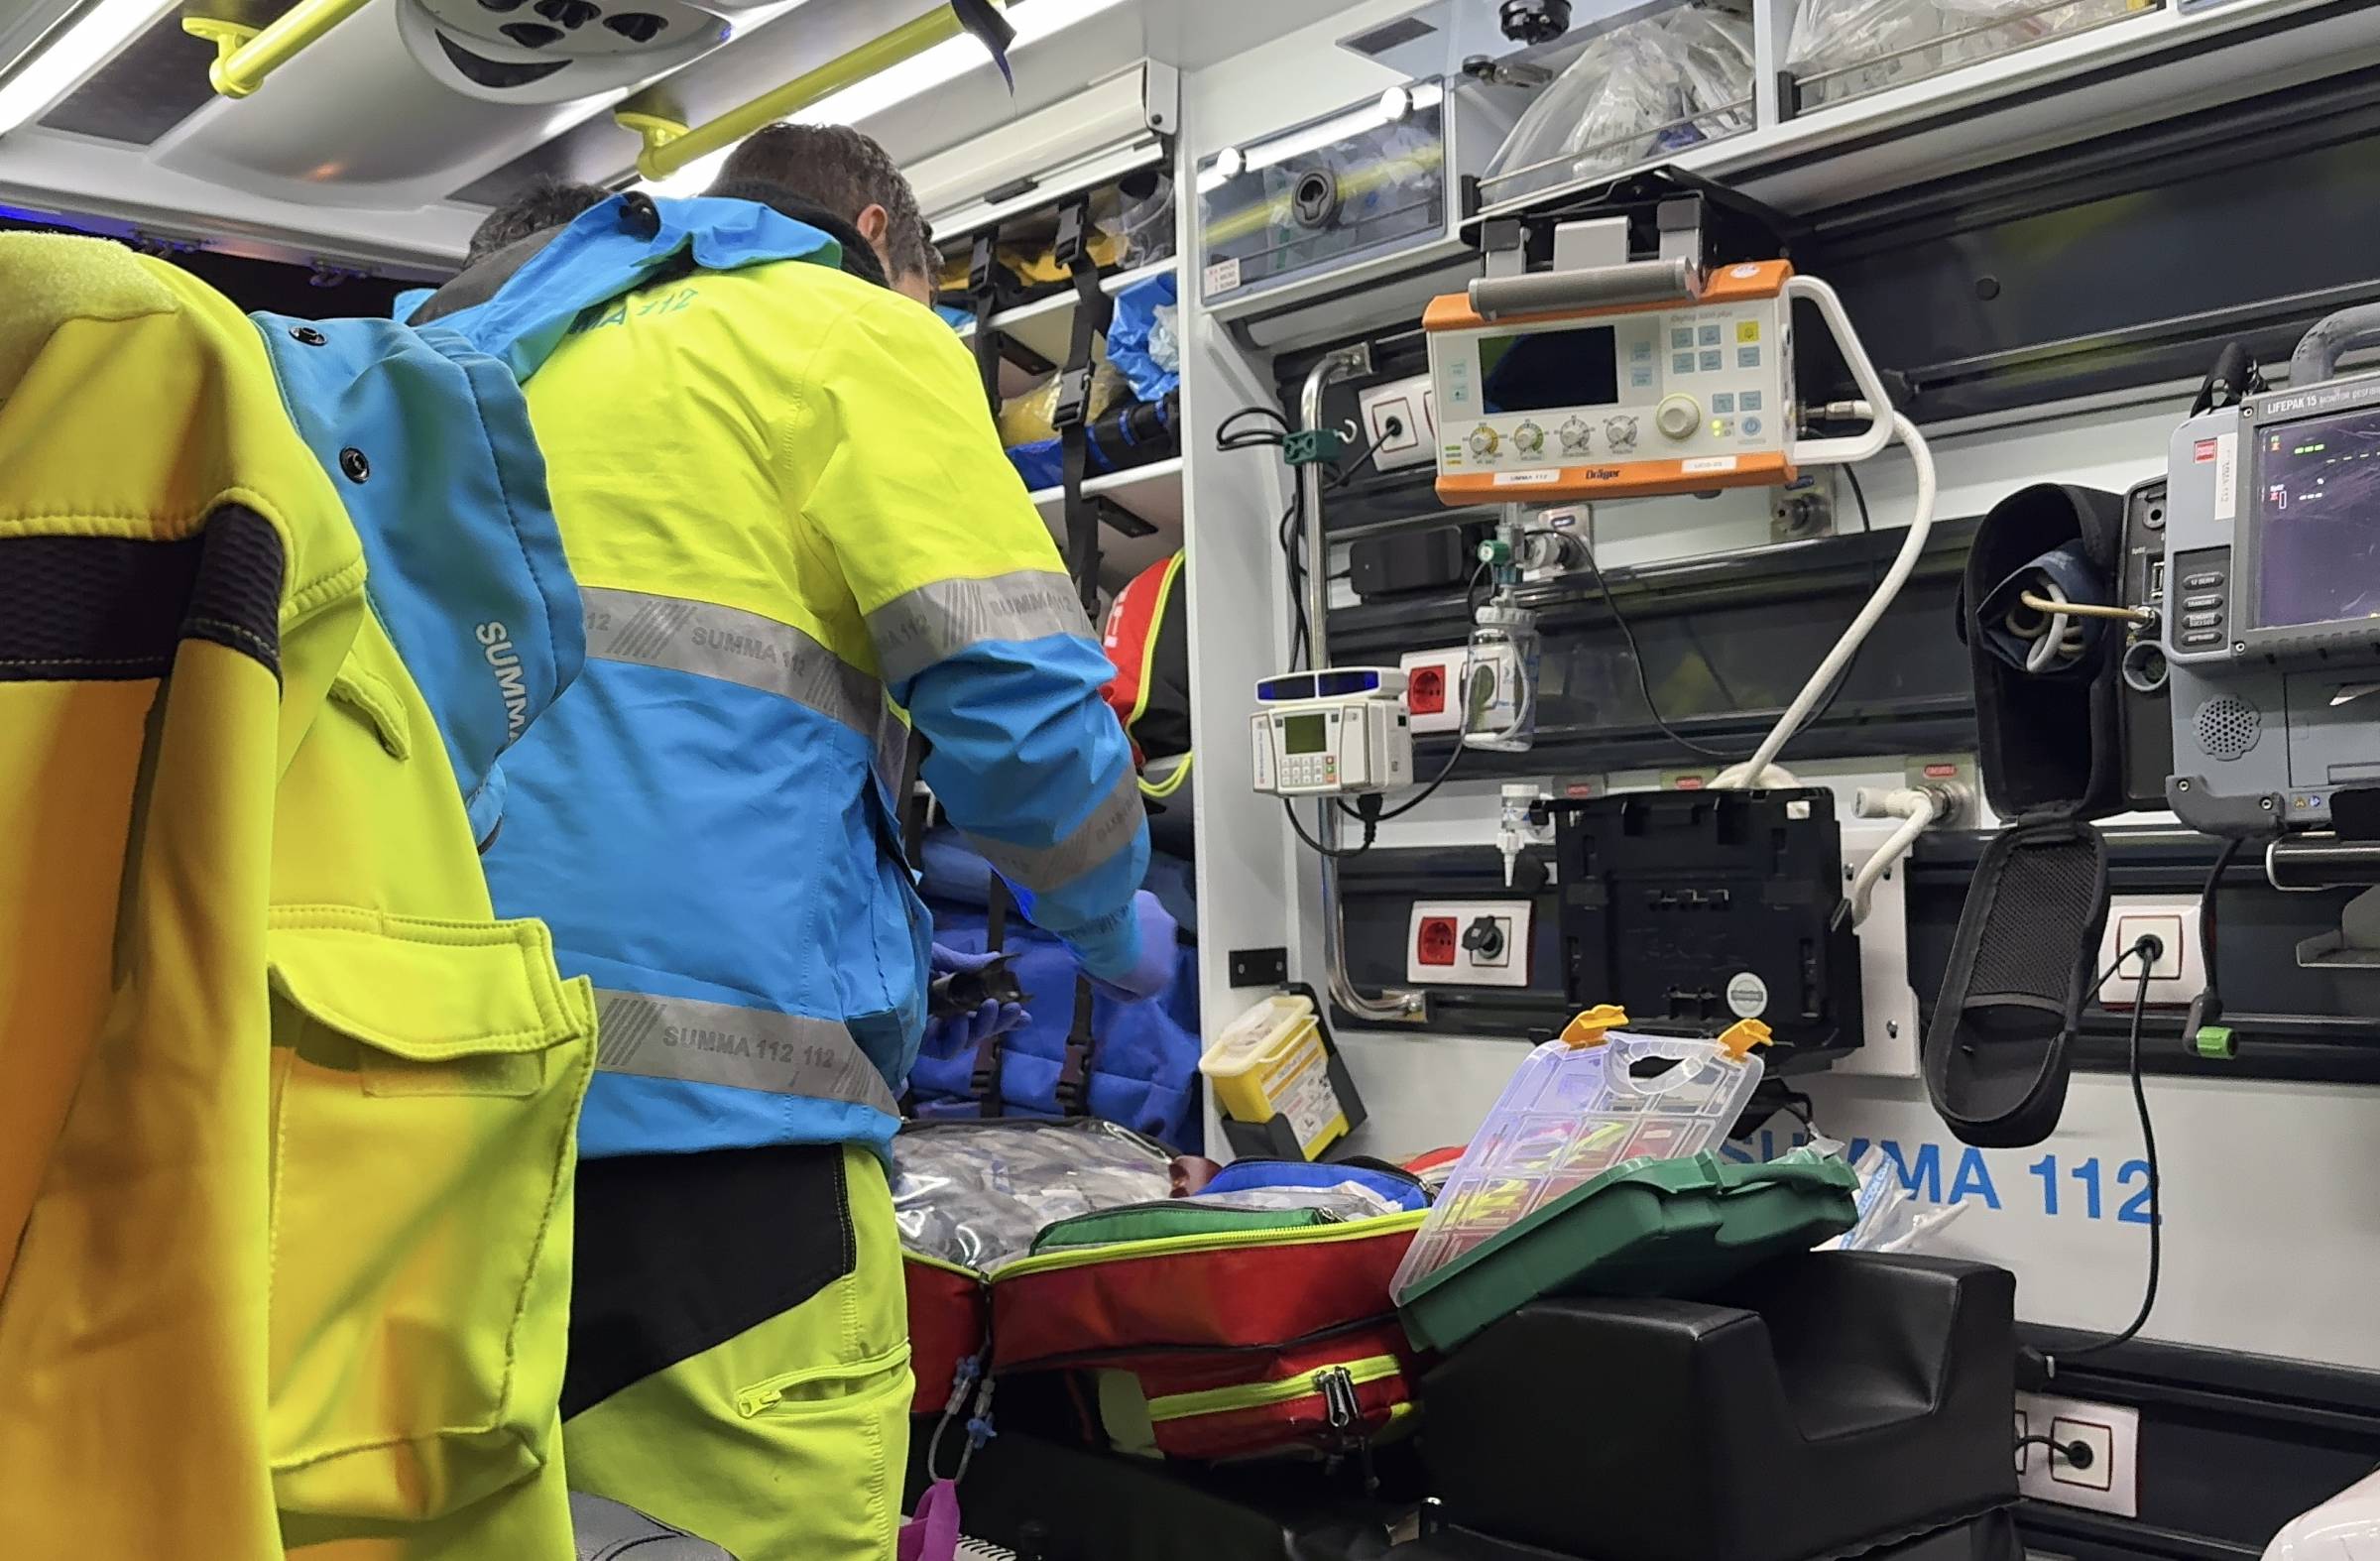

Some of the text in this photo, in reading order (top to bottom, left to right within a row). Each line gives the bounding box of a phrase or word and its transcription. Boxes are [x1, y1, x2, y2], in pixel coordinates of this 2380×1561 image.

[2267, 398, 2305, 415] LIFEPAK
[2307, 395, 2318, 407] 15
[1585, 468, 1620, 481] Dräger
[690, 626, 777, 662] SUMMA
[781, 652, 806, 678] 112
[661, 1024, 836, 1069] SUMMA 112 112
[2029, 1153, 2163, 1227] 112
